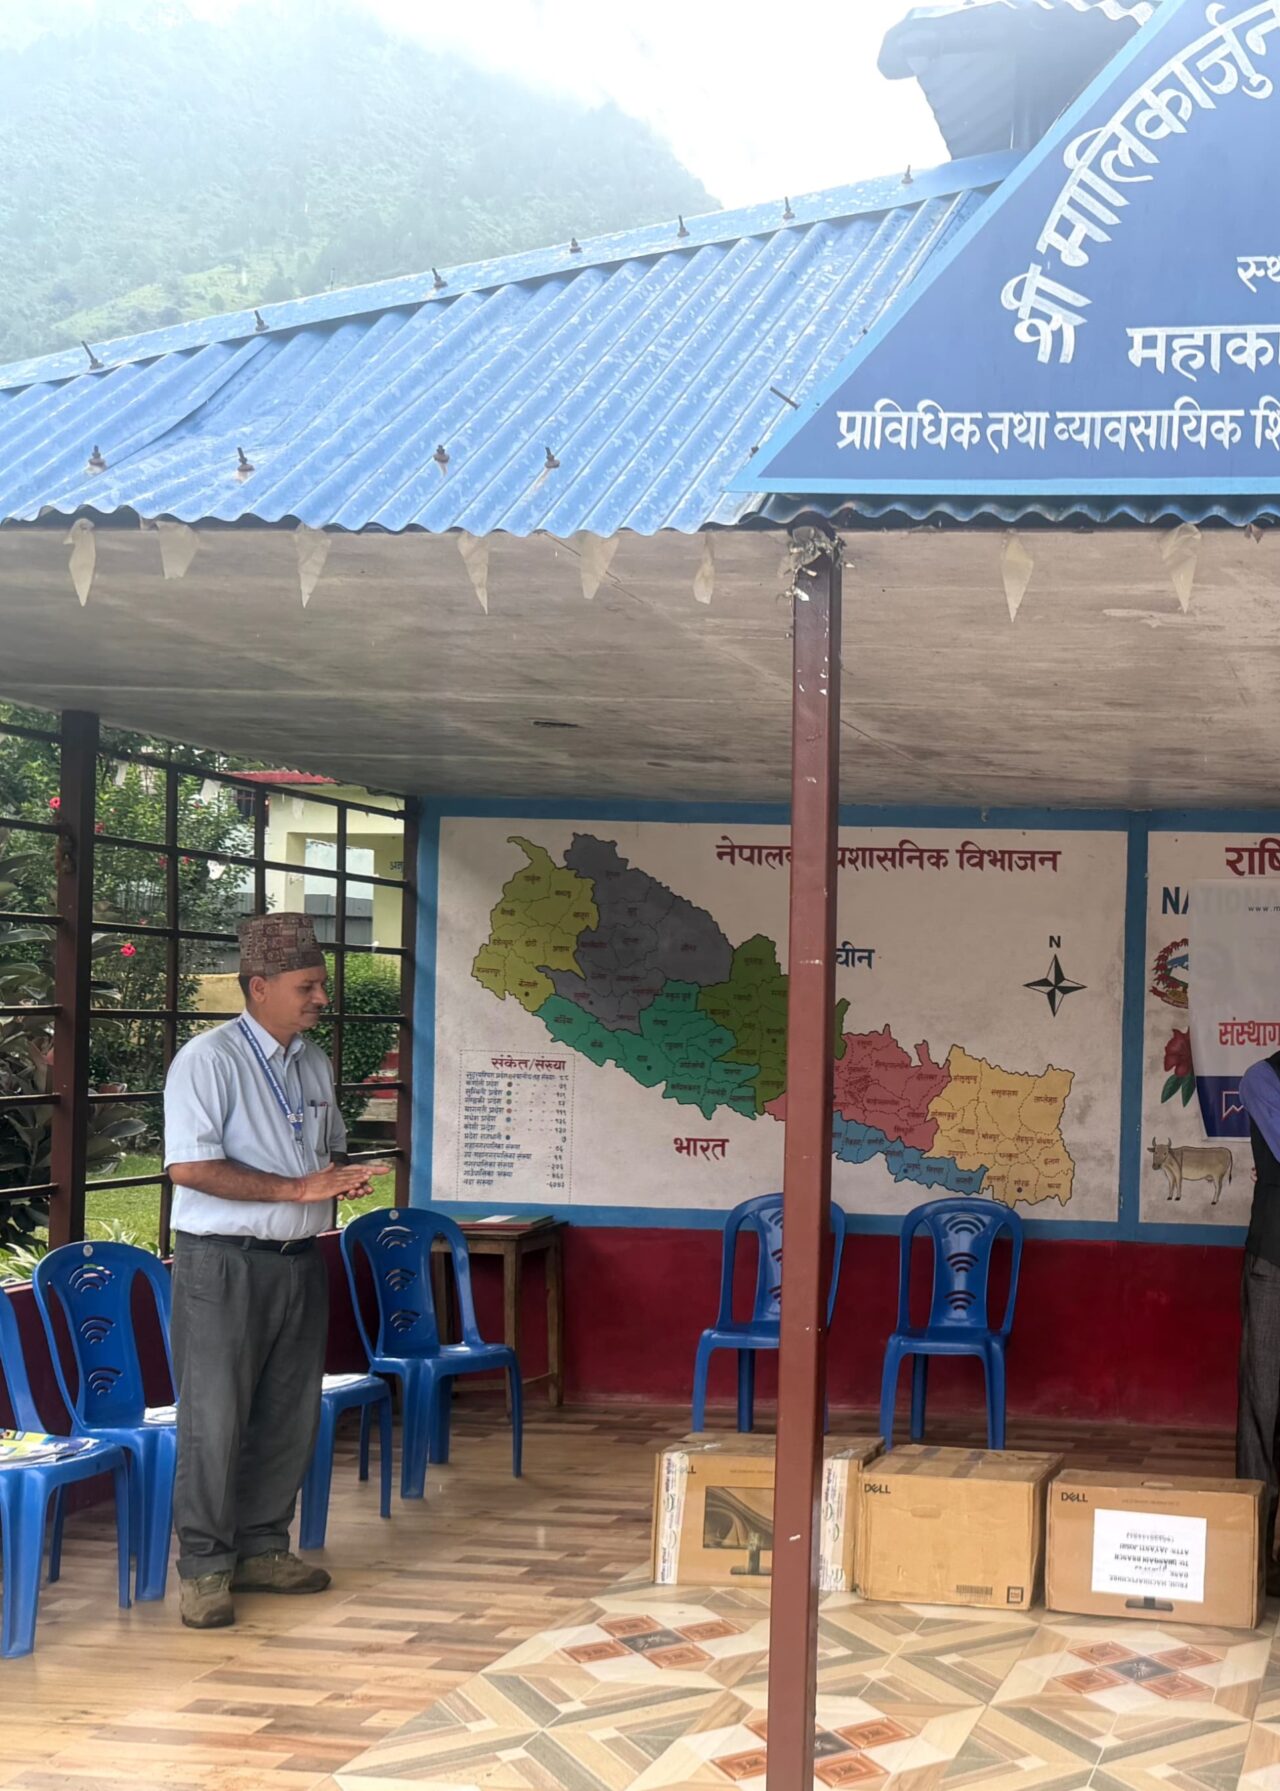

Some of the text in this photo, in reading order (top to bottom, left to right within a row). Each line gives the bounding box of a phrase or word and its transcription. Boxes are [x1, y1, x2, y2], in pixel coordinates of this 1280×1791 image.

[1001, 263, 1093, 364] श्री
[836, 397, 983, 451] प्राविधिक
[985, 411, 1050, 455] तथा
[1053, 395, 1245, 453] व्यावसायिक
[716, 835, 792, 870] नेपाल
[956, 840, 1062, 872] विभाजन
[1049, 935, 1062, 948] N
[673, 1136, 729, 1162] भारत
[863, 1482, 892, 1495] DELL
[1060, 1491, 1089, 1503] DELL
